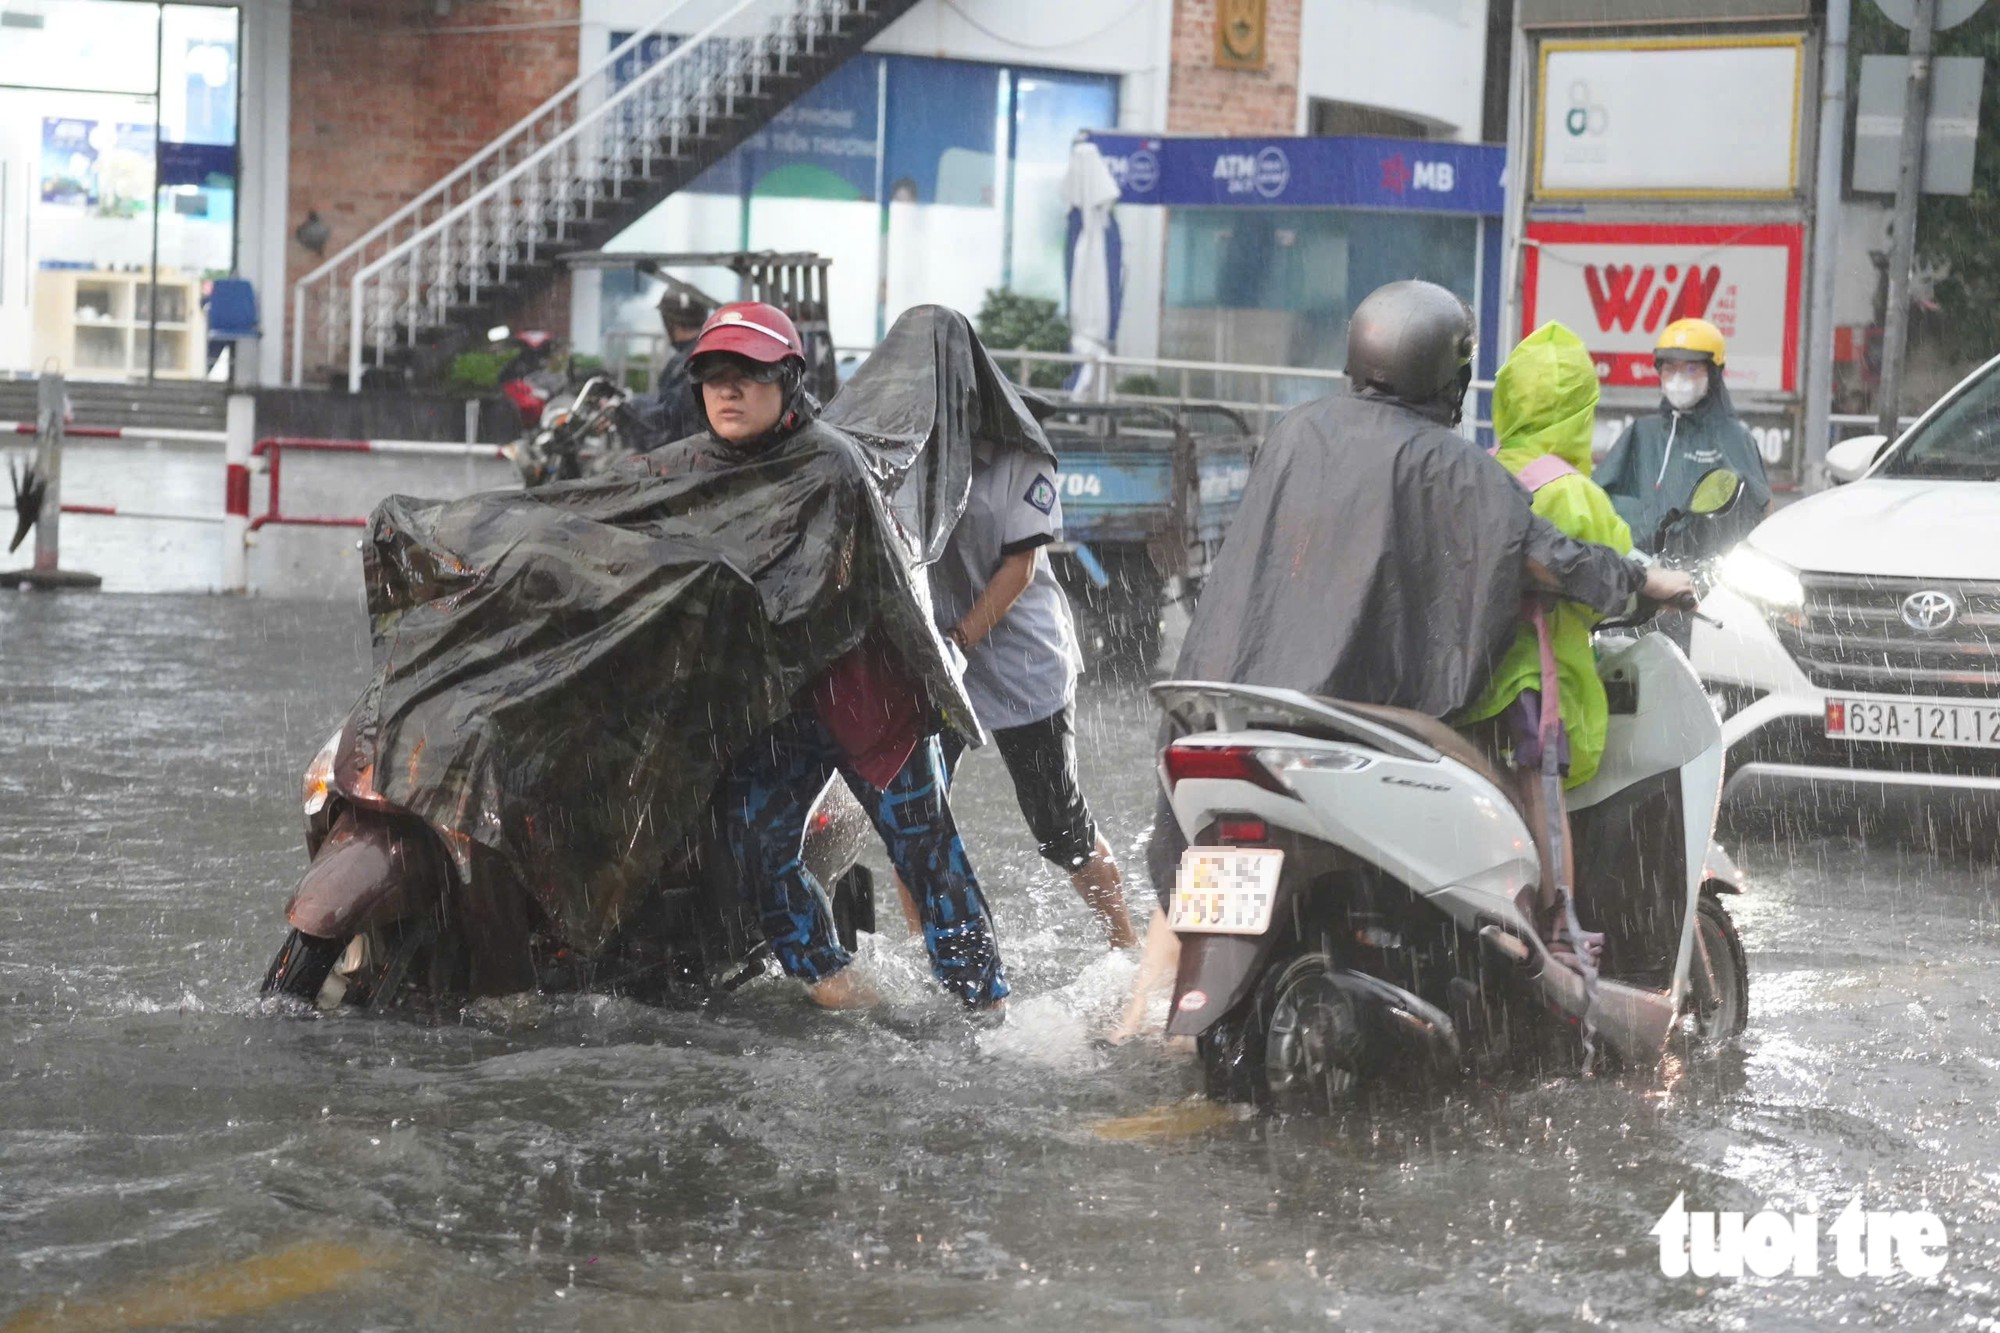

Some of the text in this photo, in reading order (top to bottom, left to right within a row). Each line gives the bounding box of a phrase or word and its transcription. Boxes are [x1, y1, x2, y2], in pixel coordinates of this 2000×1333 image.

[1213, 154, 1256, 178] ATM
[1413, 160, 1454, 191] MB
[1850, 703, 2000, 744] 63A-121.12
